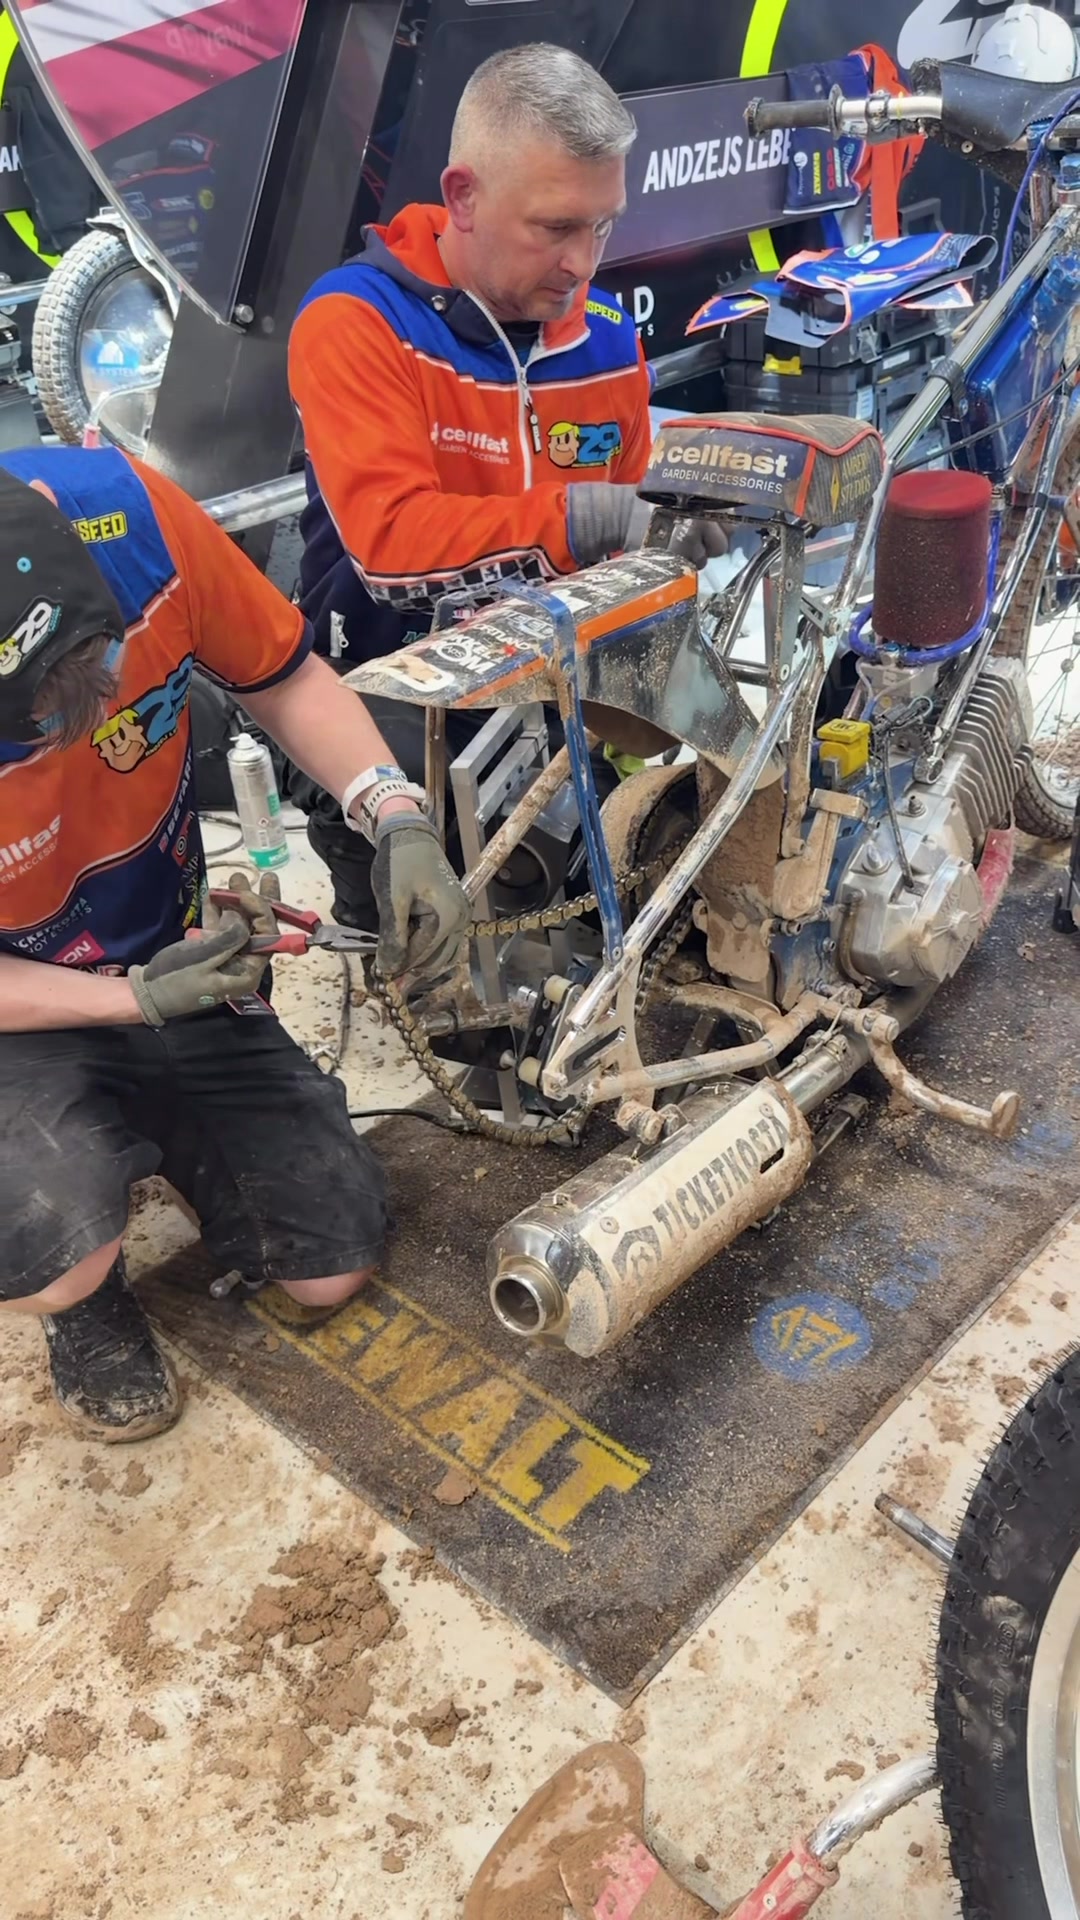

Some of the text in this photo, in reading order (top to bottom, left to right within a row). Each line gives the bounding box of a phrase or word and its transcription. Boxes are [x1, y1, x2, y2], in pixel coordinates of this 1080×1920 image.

[642, 136, 743, 193] ANDZEJS
[661, 468, 783, 495] GARDEN ACCESSORIES
[666, 445, 788, 478] cellfast
[12, 602, 53, 654] 29
[133, 656, 193, 745] 29
[652, 1117, 790, 1239] TICKETKOSTA
